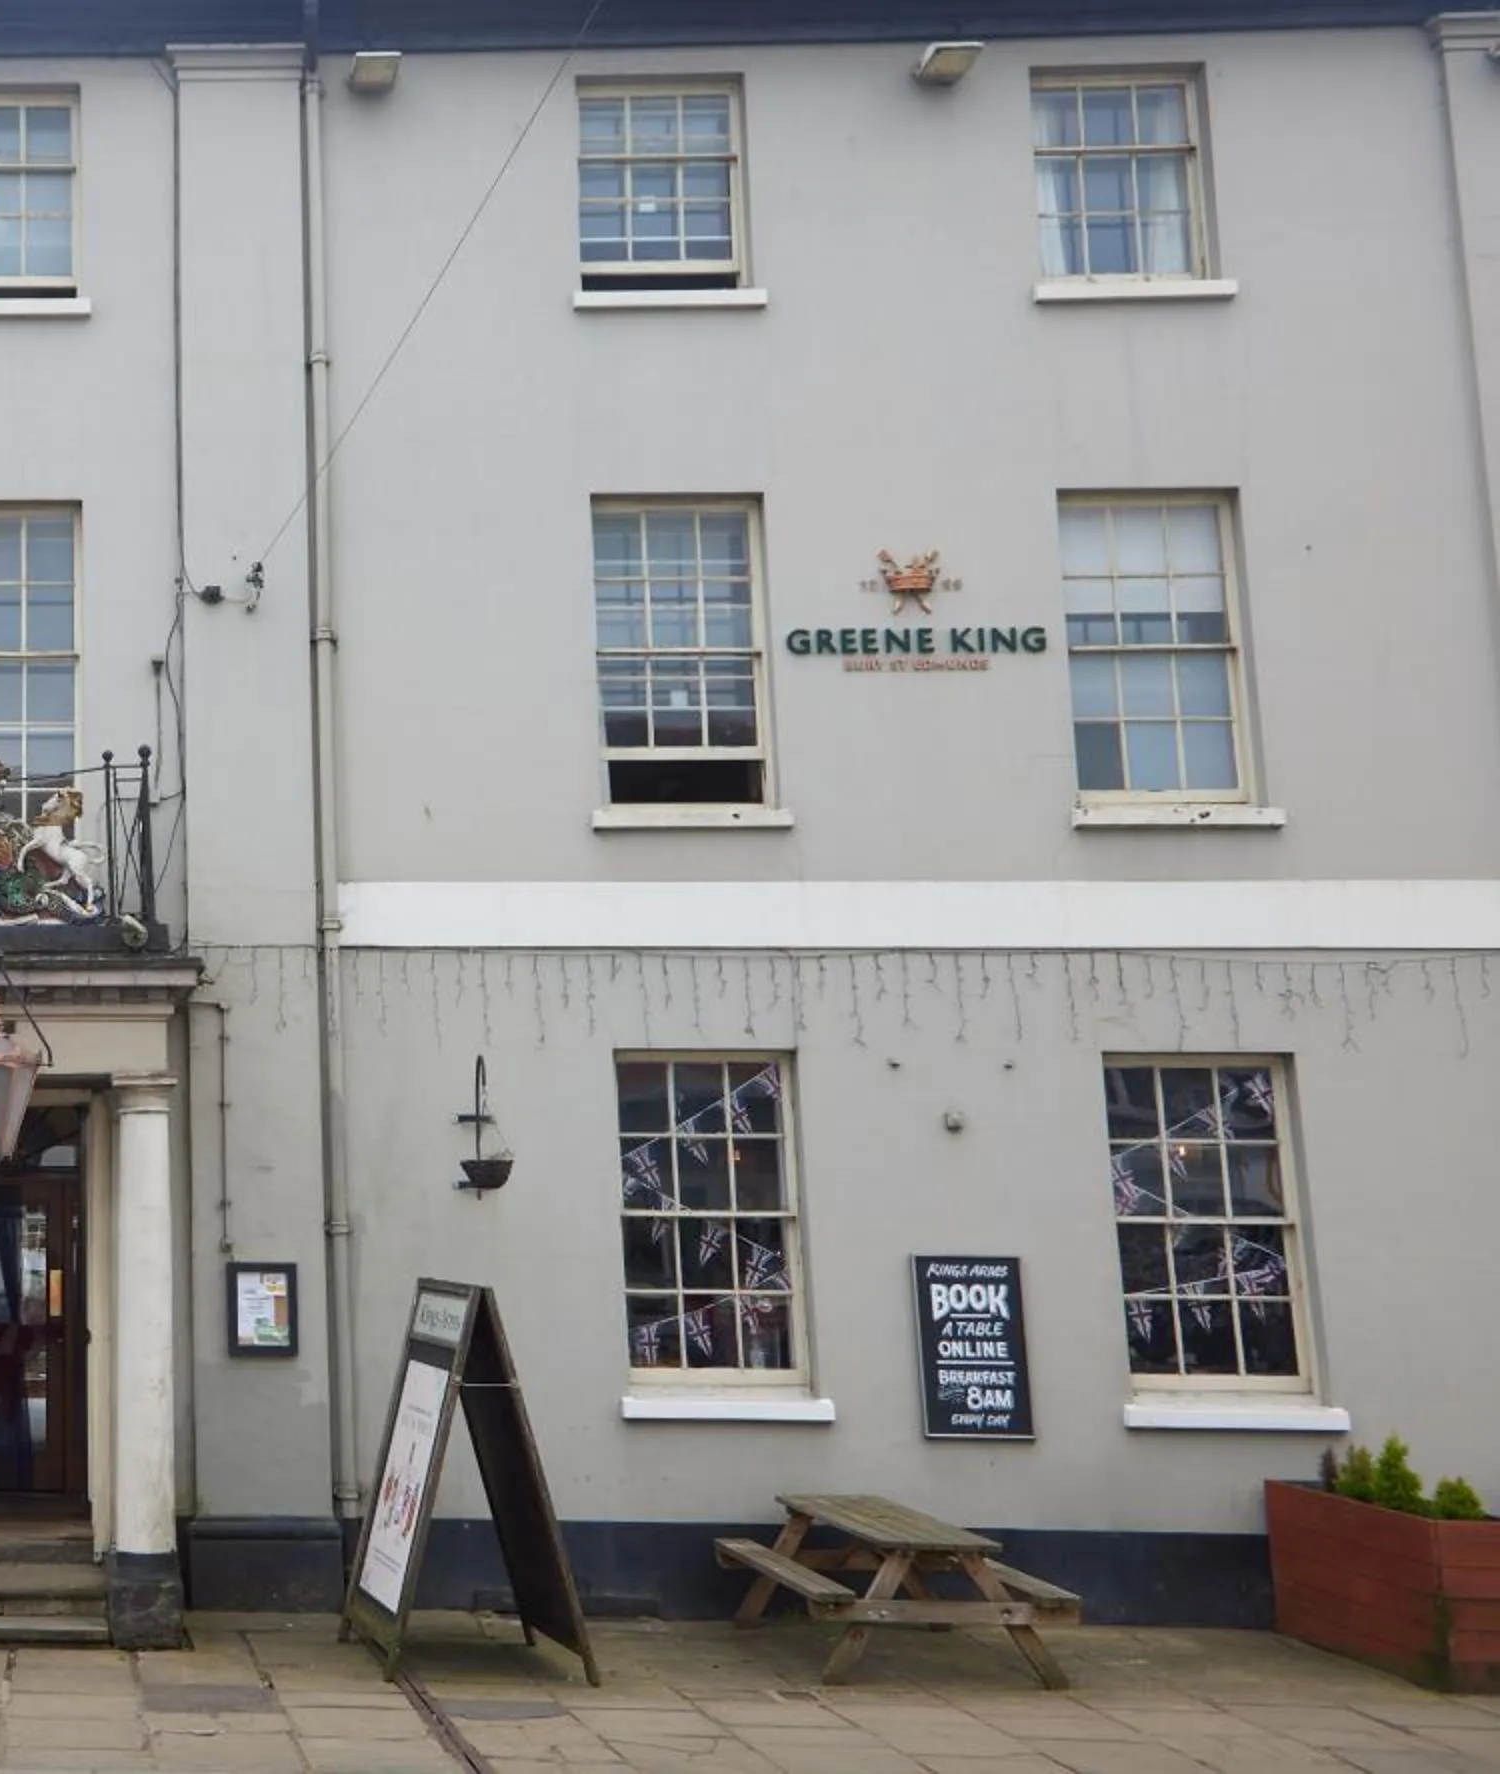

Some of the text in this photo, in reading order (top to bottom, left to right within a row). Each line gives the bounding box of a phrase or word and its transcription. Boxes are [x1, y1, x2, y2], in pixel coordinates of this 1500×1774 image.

[786, 626, 1049, 656] GREENE KING
[926, 1261, 1009, 1278] KINGS ARMS
[929, 1283, 1011, 1321] BOOK
[941, 1321, 1005, 1337] A TABLE
[937, 1340, 1009, 1358] ONLINE
[937, 1369, 1016, 1386] BREAKFAST
[966, 1385, 1015, 1411] 8AM
